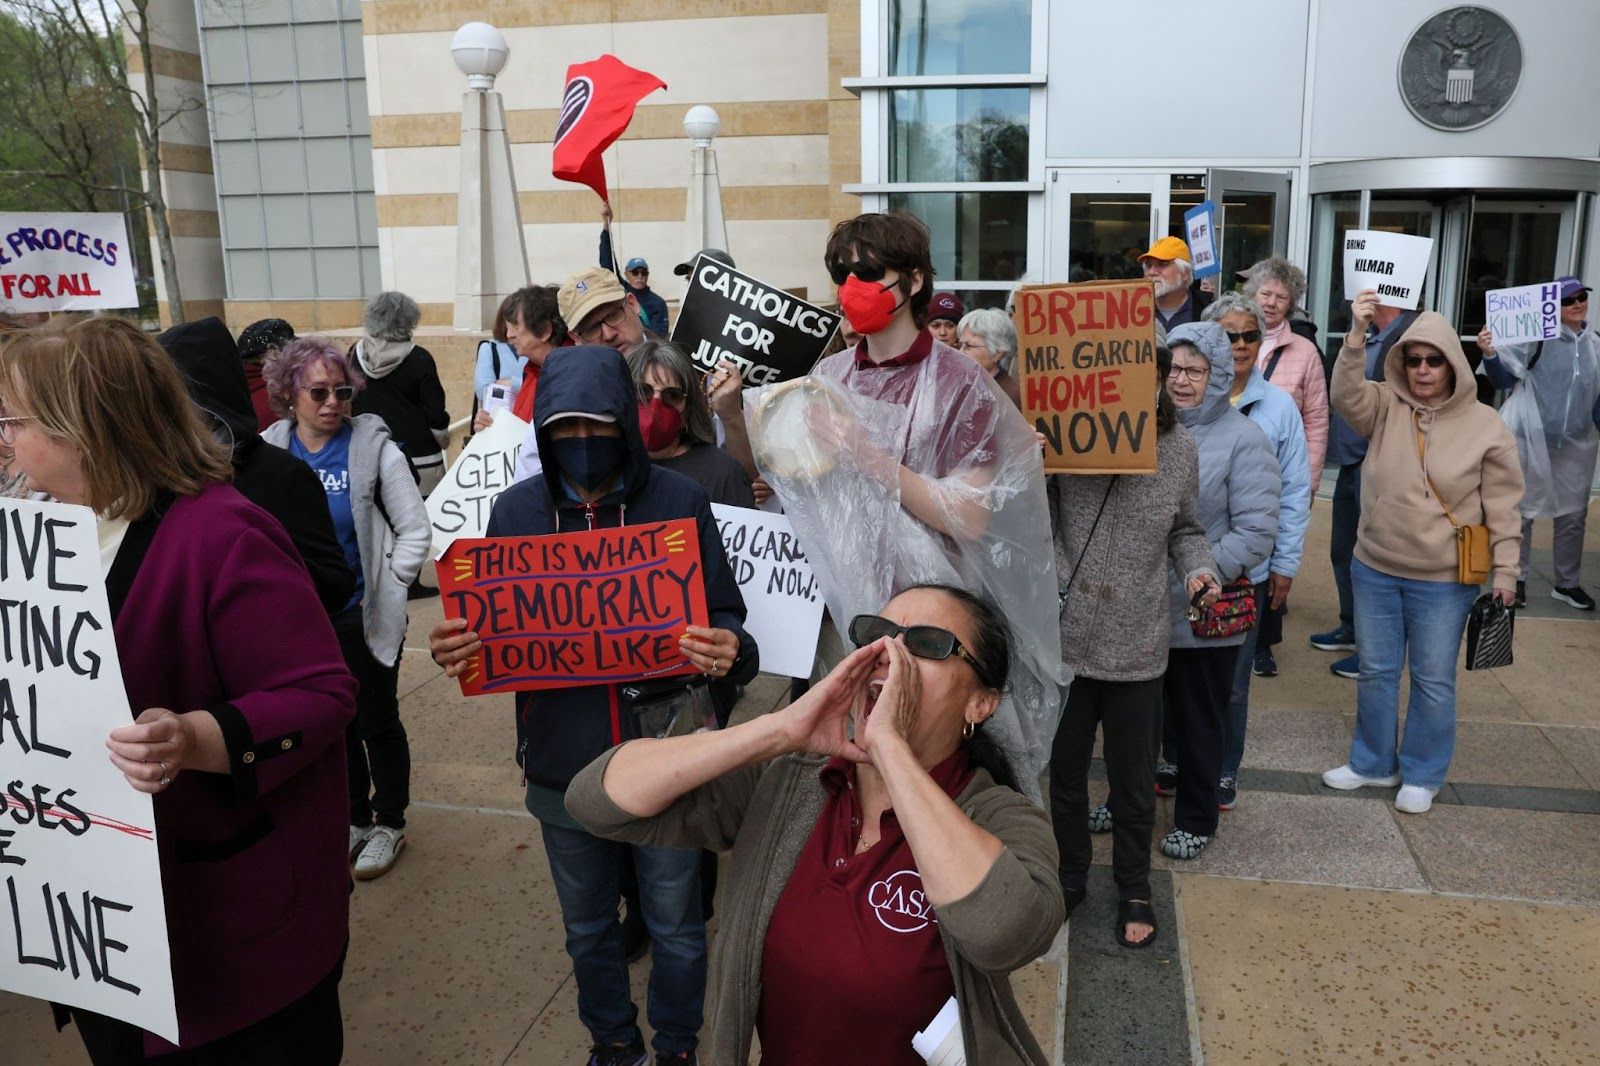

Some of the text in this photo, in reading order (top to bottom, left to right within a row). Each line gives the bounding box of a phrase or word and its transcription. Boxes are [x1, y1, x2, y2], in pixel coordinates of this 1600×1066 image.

[6, 227, 118, 267] PROCESS
[1346, 239, 1367, 250] BRING
[0, 272, 101, 299] FOR ALL
[1354, 258, 1395, 275] KILMAR
[699, 265, 833, 338] CATHOLICS
[1022, 287, 1154, 337] BRING
[1377, 283, 1410, 299] HOME!
[1488, 292, 1531, 312] BRING
[1541, 284, 1558, 338] HOME
[721, 314, 775, 355] FOR
[1489, 311, 1542, 339] KILMAR
[1025, 340, 1154, 374] MR. GARCIA
[1026, 370, 1122, 412] HOME
[1035, 410, 1149, 458] NOW
[456, 444, 522, 489] GEN
[464, 523, 667, 579] THIS IS WHAT
[447, 560, 698, 636] DEMOCRACY
[484, 630, 680, 681] LOOKS LIKE
[6, 875, 141, 996] LINE
